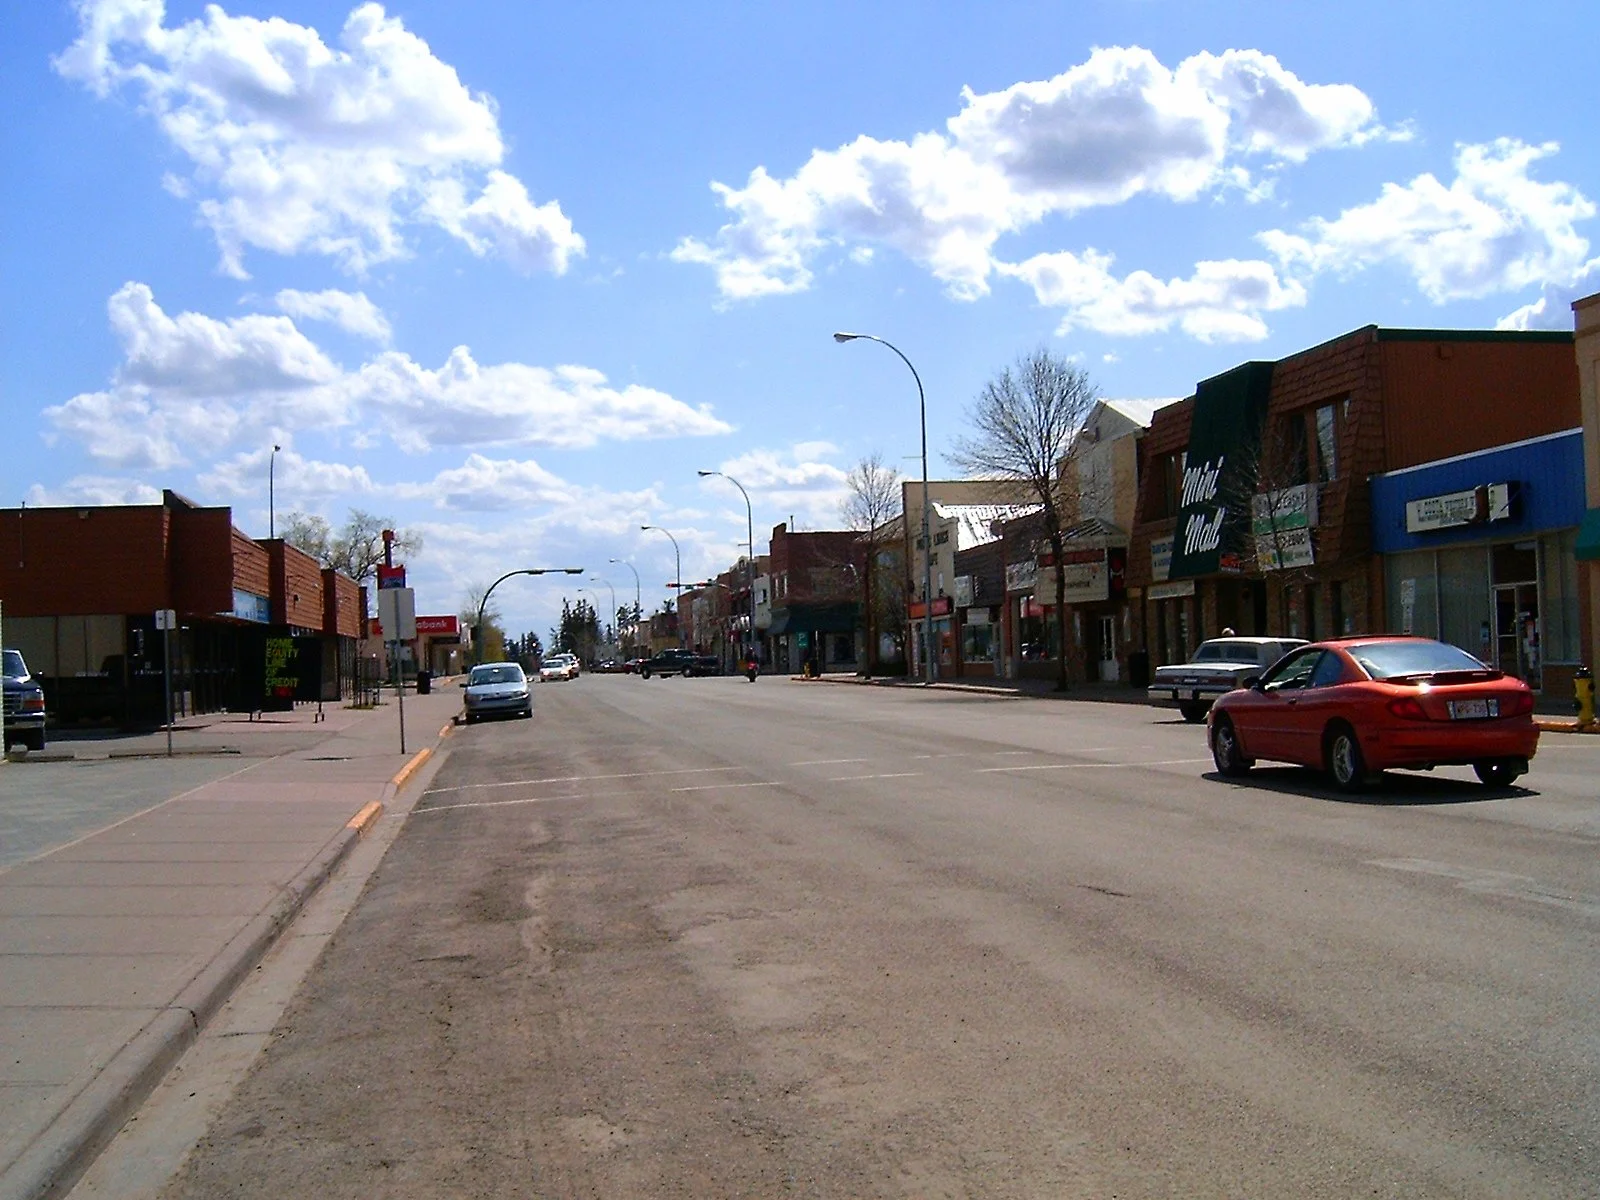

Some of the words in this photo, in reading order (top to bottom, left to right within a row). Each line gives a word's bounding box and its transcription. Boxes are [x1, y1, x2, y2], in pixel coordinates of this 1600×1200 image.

[1181, 456, 1224, 508] Mini
[1184, 507, 1226, 556] Mall
[265, 677, 300, 688] CREDIT
